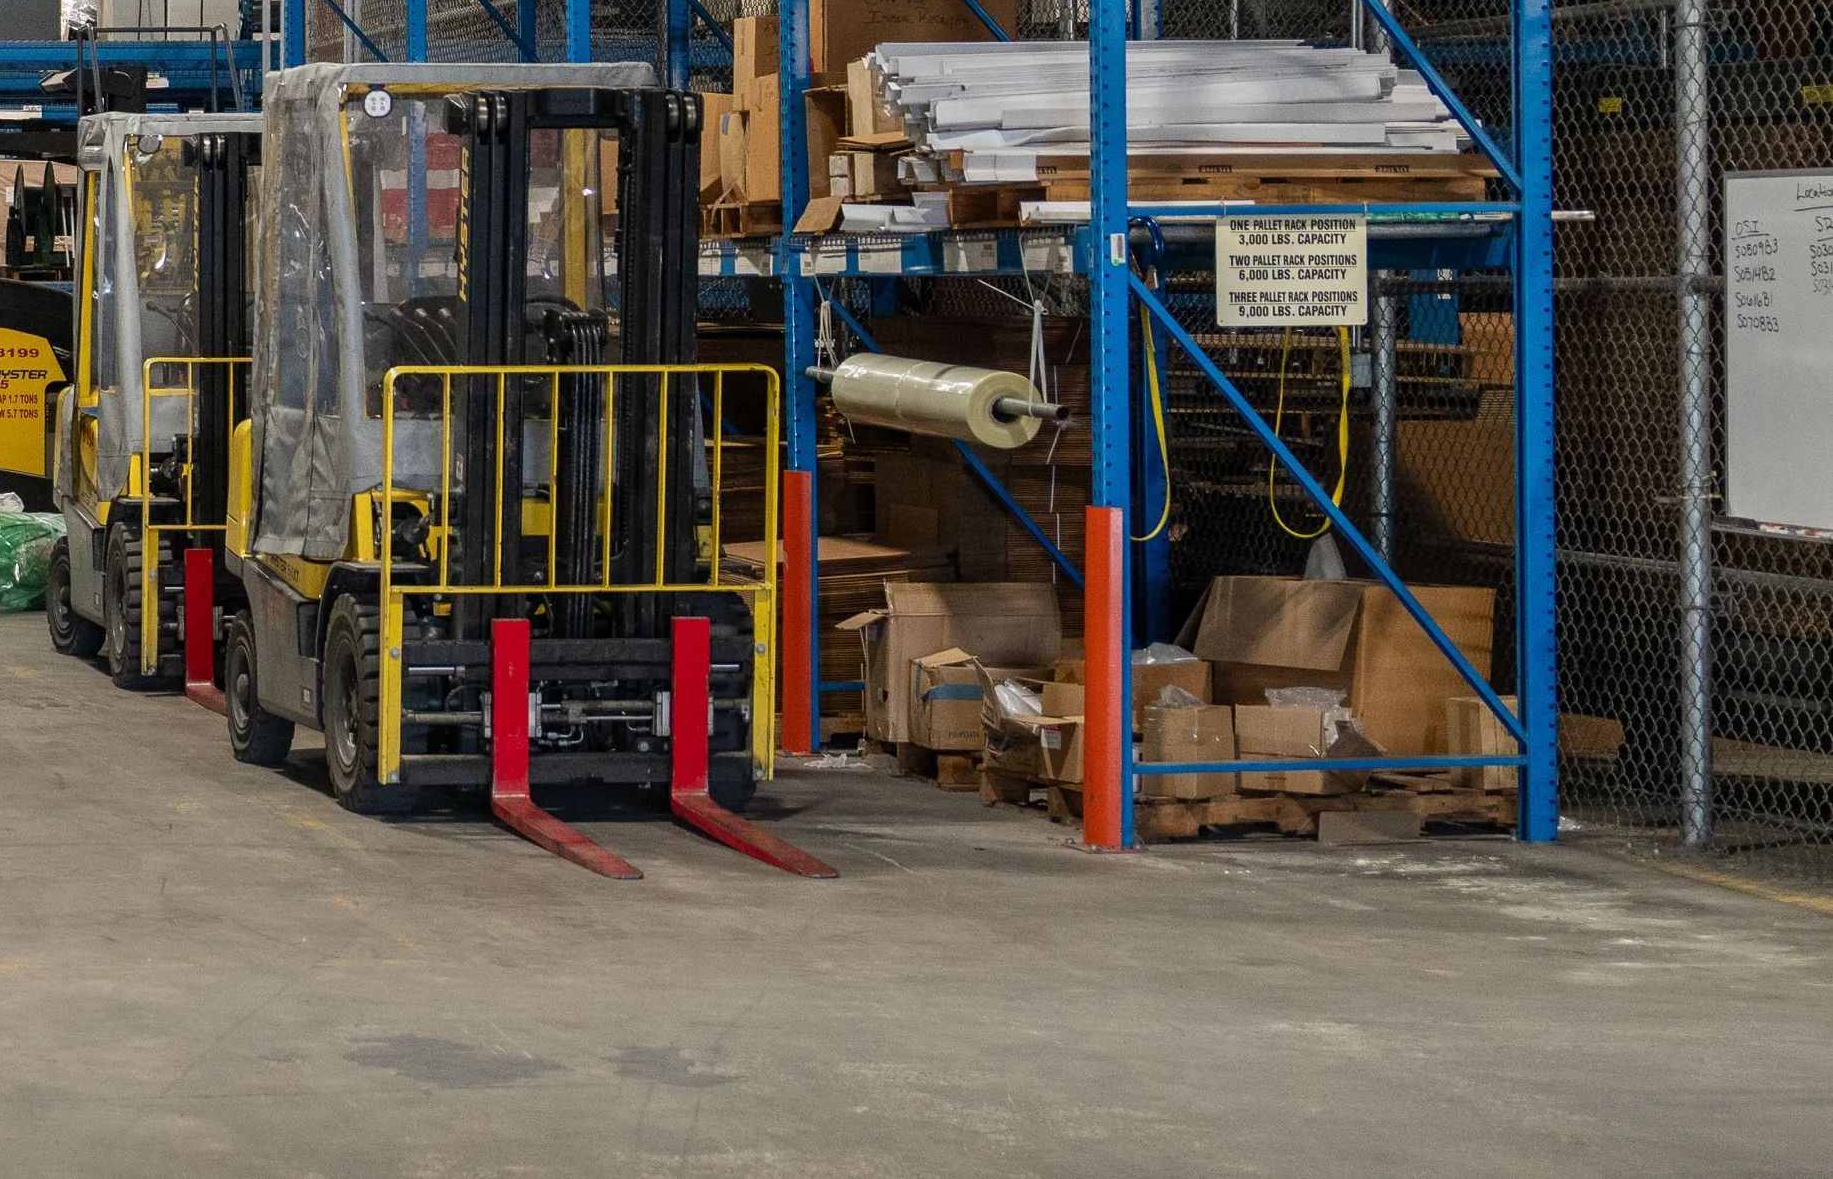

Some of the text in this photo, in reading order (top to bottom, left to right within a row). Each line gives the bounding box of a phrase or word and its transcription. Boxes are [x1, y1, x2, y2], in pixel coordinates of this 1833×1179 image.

[1230, 219, 1356, 231] ONE PALLET RACK POSITION
[1239, 233, 1347, 246] 3,000 LBS. CAPACITY
[1229, 254, 1357, 266] TWO PALLET RACK POSITIONS
[1239, 269, 1347, 282] 6,000 LBS. CAPACITY
[1229, 291, 1358, 303] THREE PALLET RACK POSITIONS
[1239, 305, 1347, 319] 9,000 LBS. CAPACITY
[8, 394, 19, 404] 1.7
[20, 394, 38, 404] TONS
[6, 409, 18, 418] 5.7
[19, 409, 39, 418] TONS
